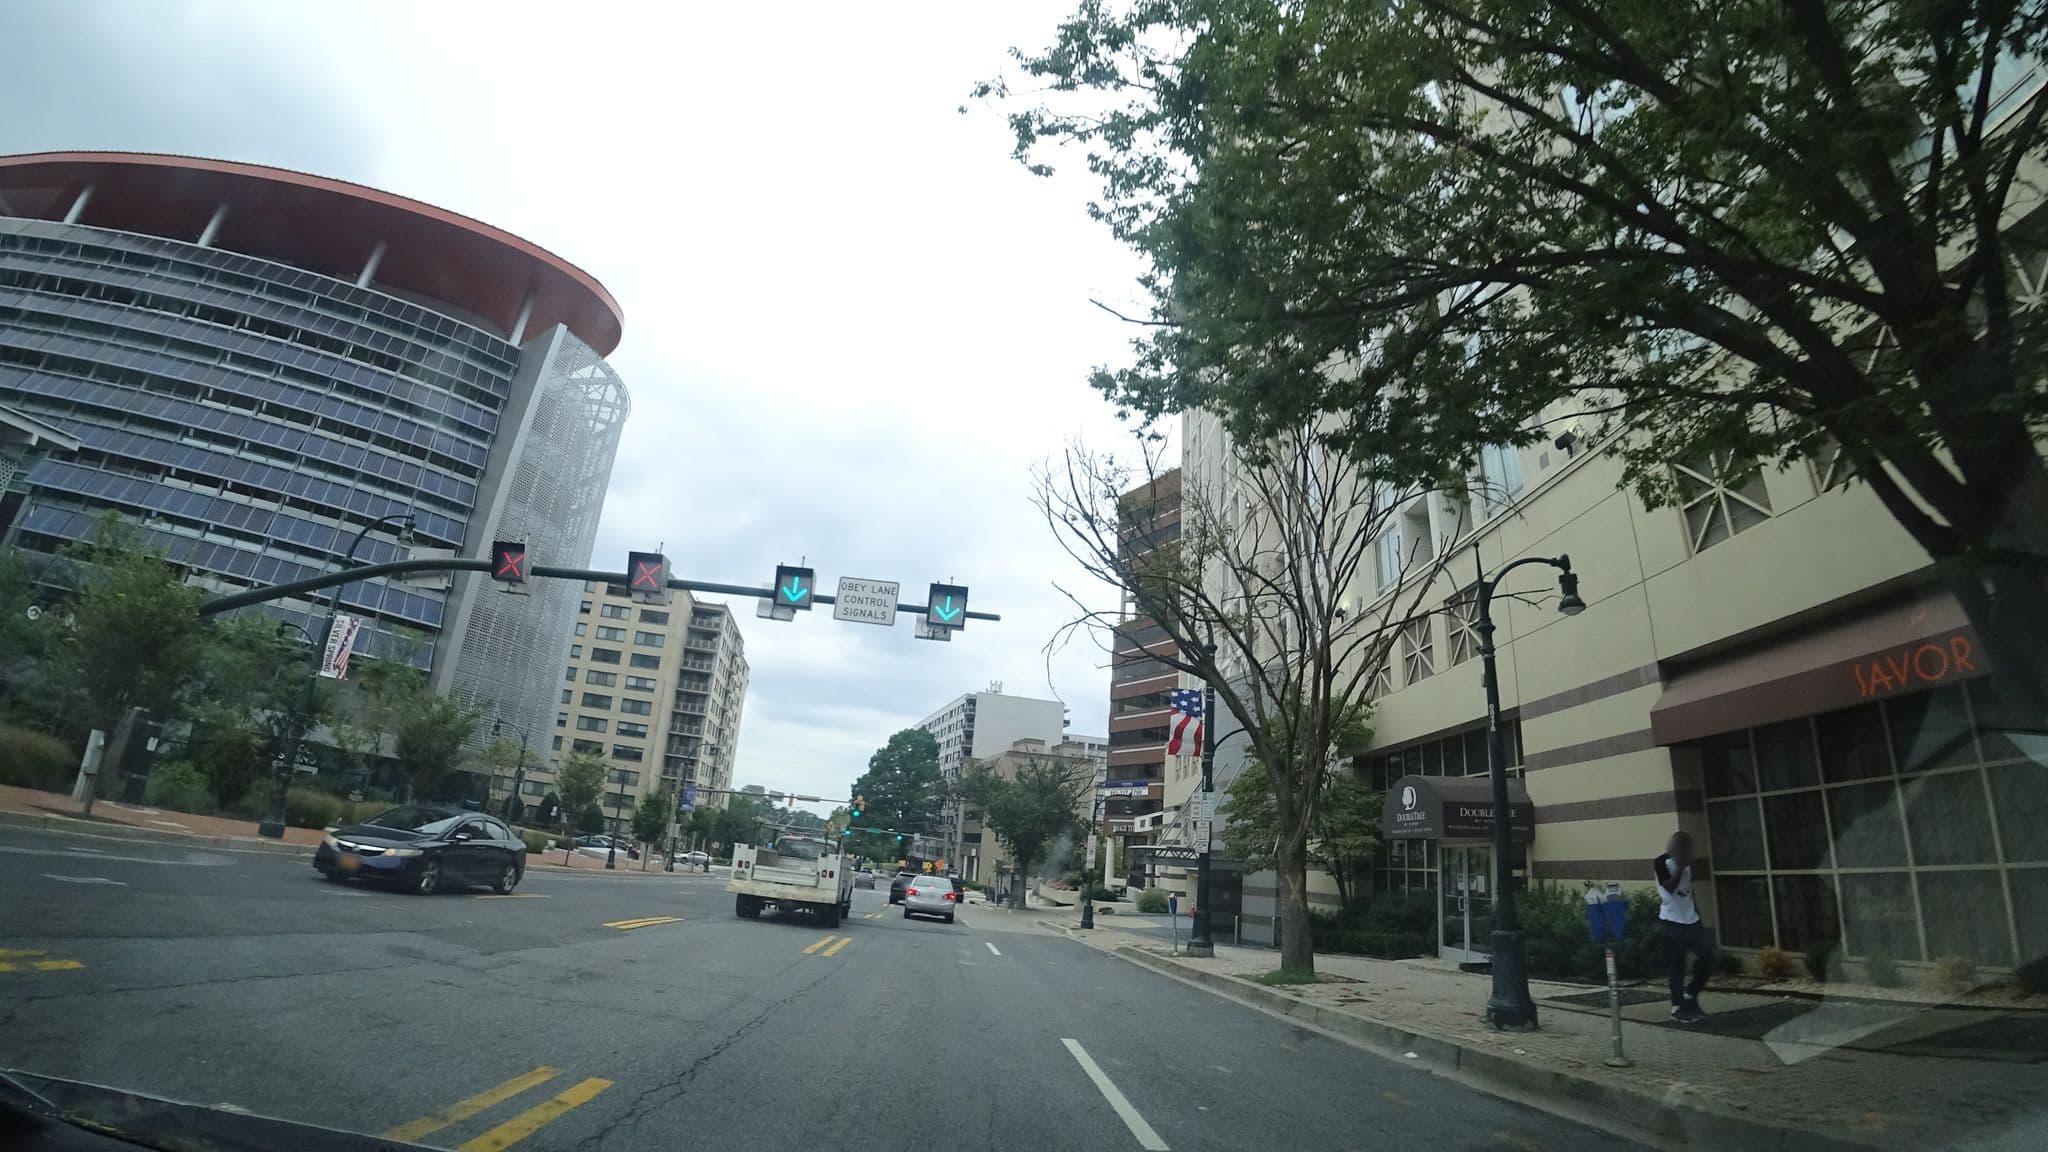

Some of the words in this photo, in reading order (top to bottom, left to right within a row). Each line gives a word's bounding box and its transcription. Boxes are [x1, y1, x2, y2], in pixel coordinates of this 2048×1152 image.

[841, 582, 867, 592] OBEY
[872, 585, 897, 596] LANE
[844, 595, 889, 608] CONTROL
[843, 607, 887, 620] SIGNALS
[331, 619, 345, 644] SILVER
[324, 645, 336, 673] SPRING
[1854, 636, 1976, 697] SAVOR
[1460, 807, 1518, 818] DOUBLEE
